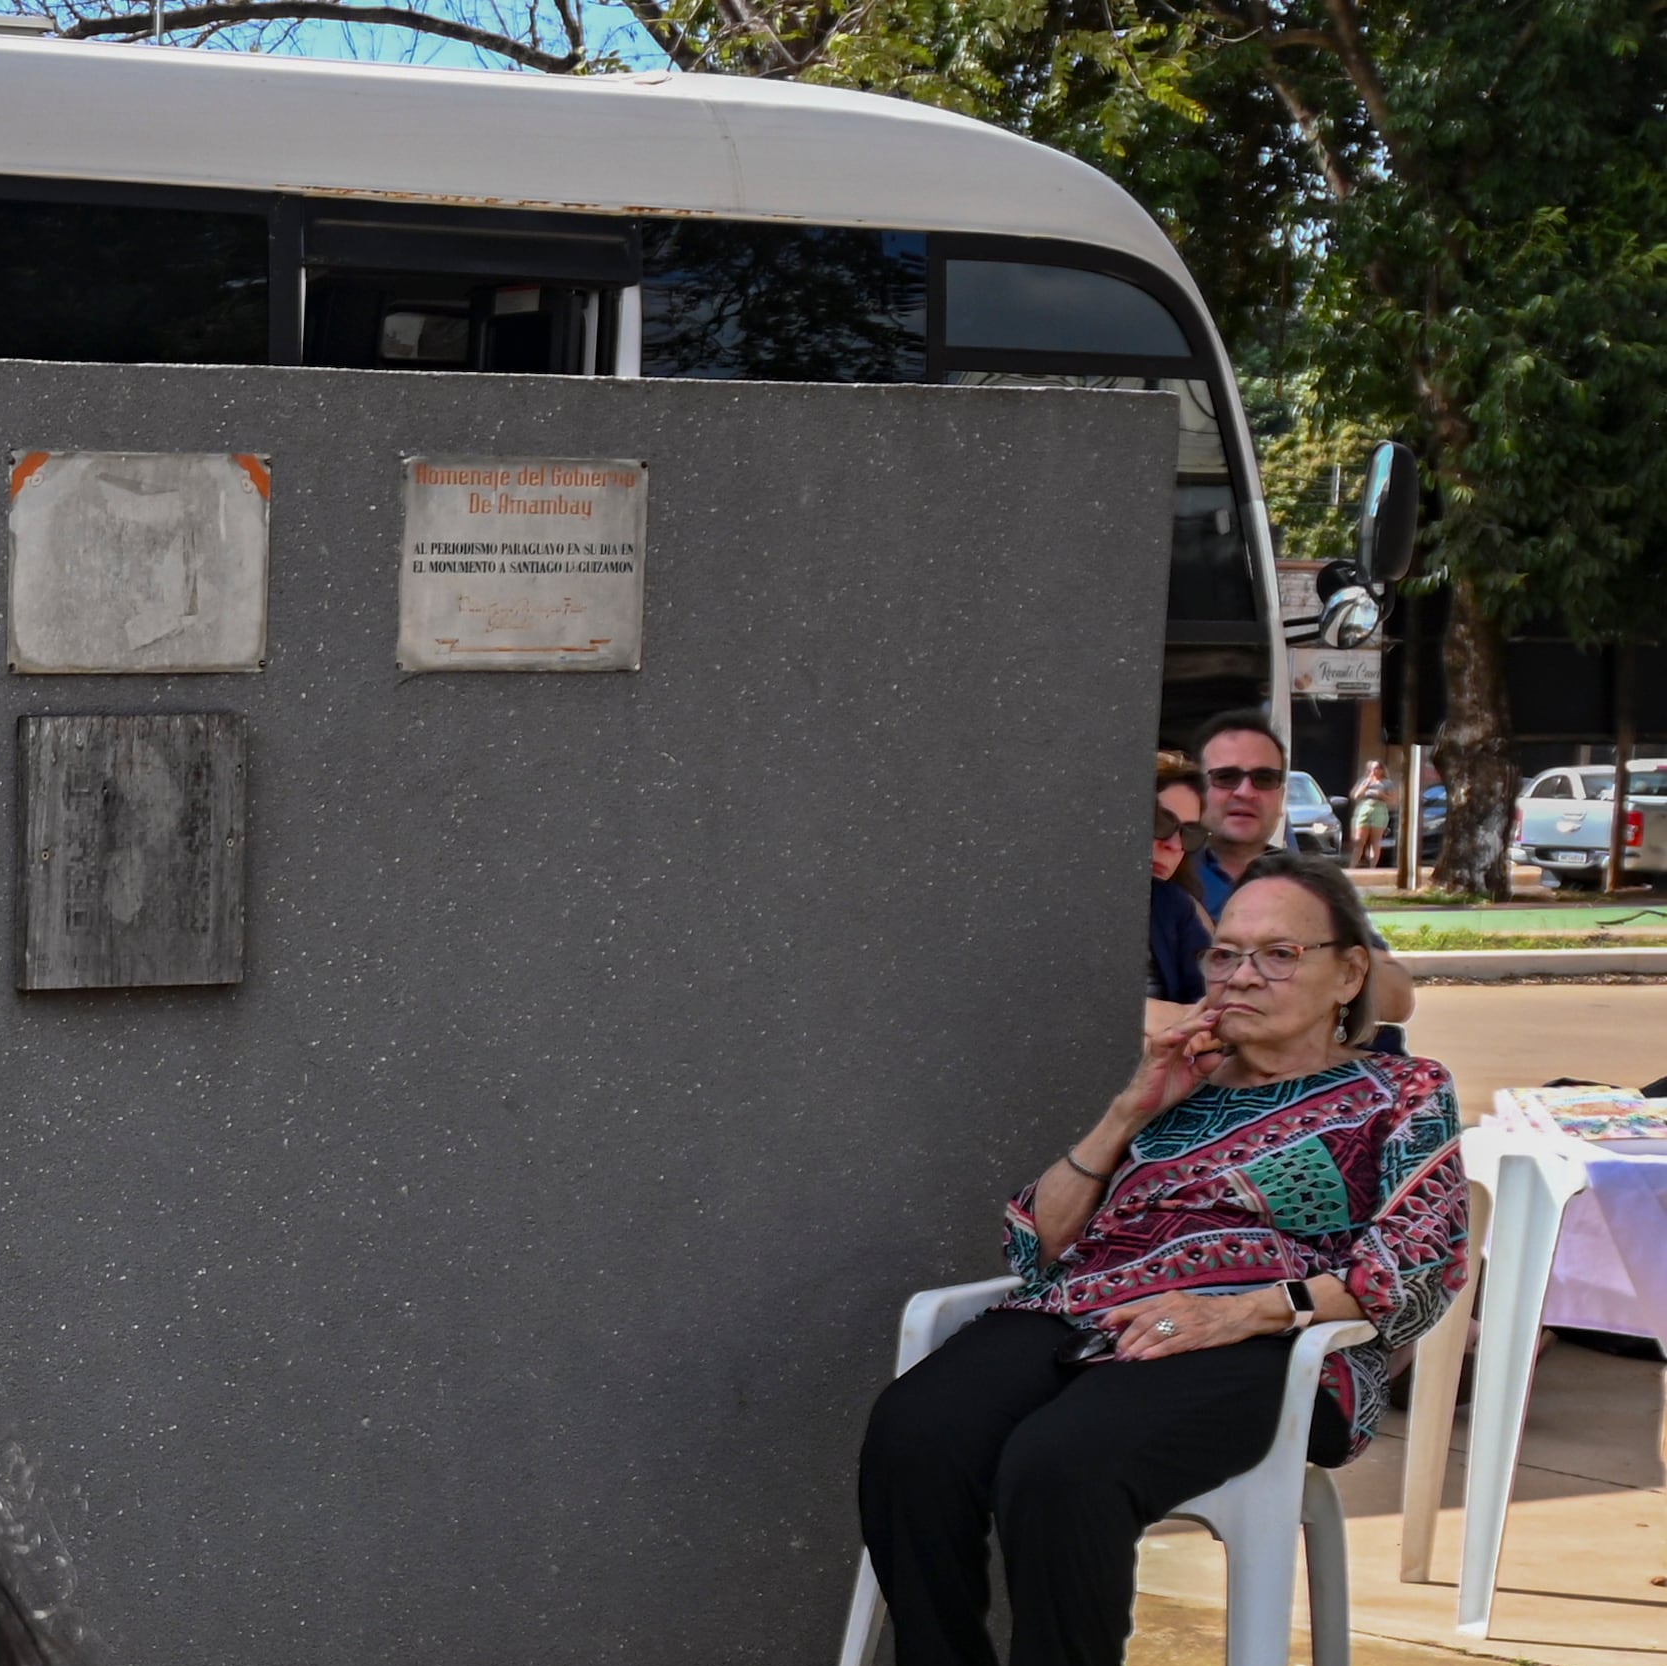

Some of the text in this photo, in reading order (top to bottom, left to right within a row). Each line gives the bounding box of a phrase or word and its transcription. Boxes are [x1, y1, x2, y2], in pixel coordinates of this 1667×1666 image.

[415, 463, 510, 491] Homenaje
[517, 465, 545, 487] del
[469, 492, 593, 520] De Amambay
[413, 542, 634, 556] AL PERIODISMO PARAGUAYO EN SU DIA EN
[412, 560, 427, 573] EL
[429, 560, 497, 574] MONUMENTO
[498, 561, 506, 574] A
[509, 560, 563, 574] SANTIAGO
